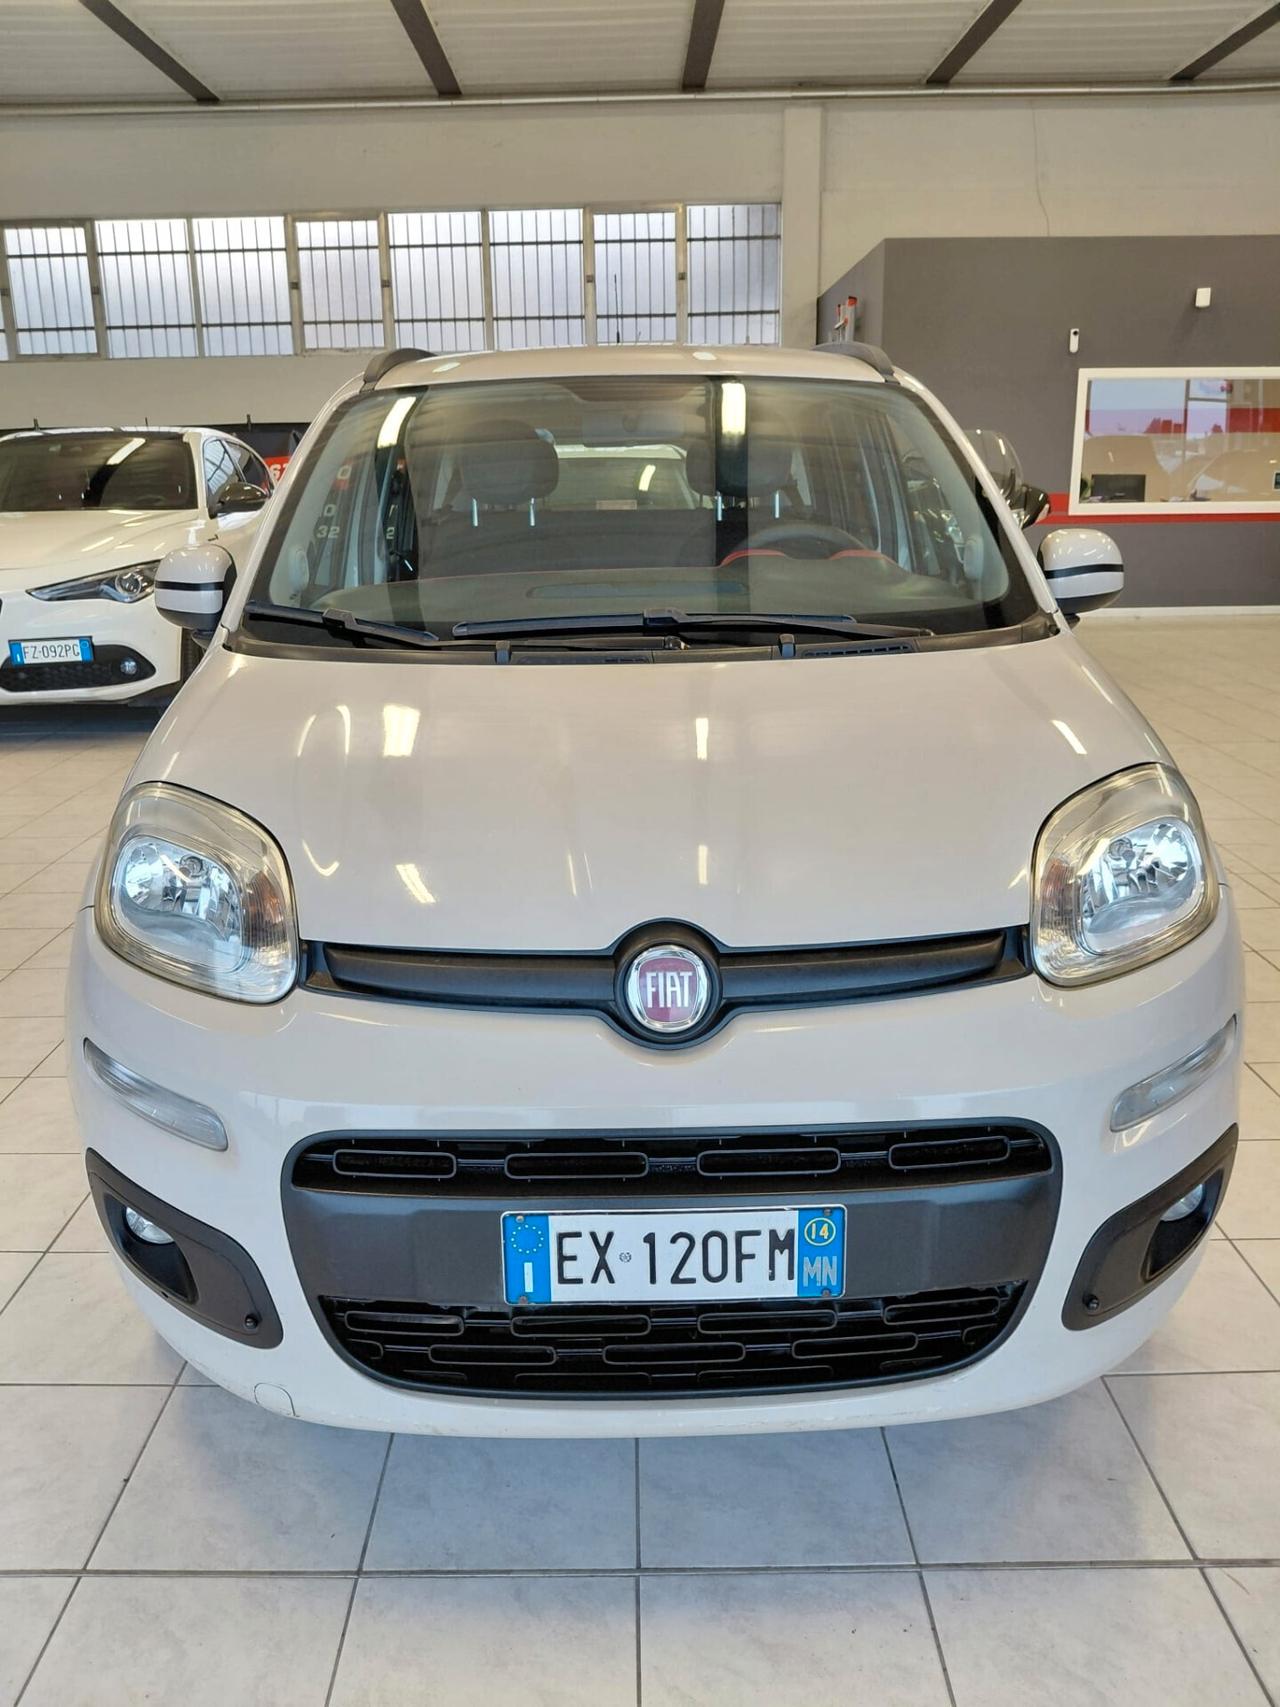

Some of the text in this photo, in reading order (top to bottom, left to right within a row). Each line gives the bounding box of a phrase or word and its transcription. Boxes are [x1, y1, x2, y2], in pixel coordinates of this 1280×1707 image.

[645, 970, 693, 1009] FIAT
[556, 1228, 795, 1285] EX 120FM
[803, 1255, 838, 1288] MN
